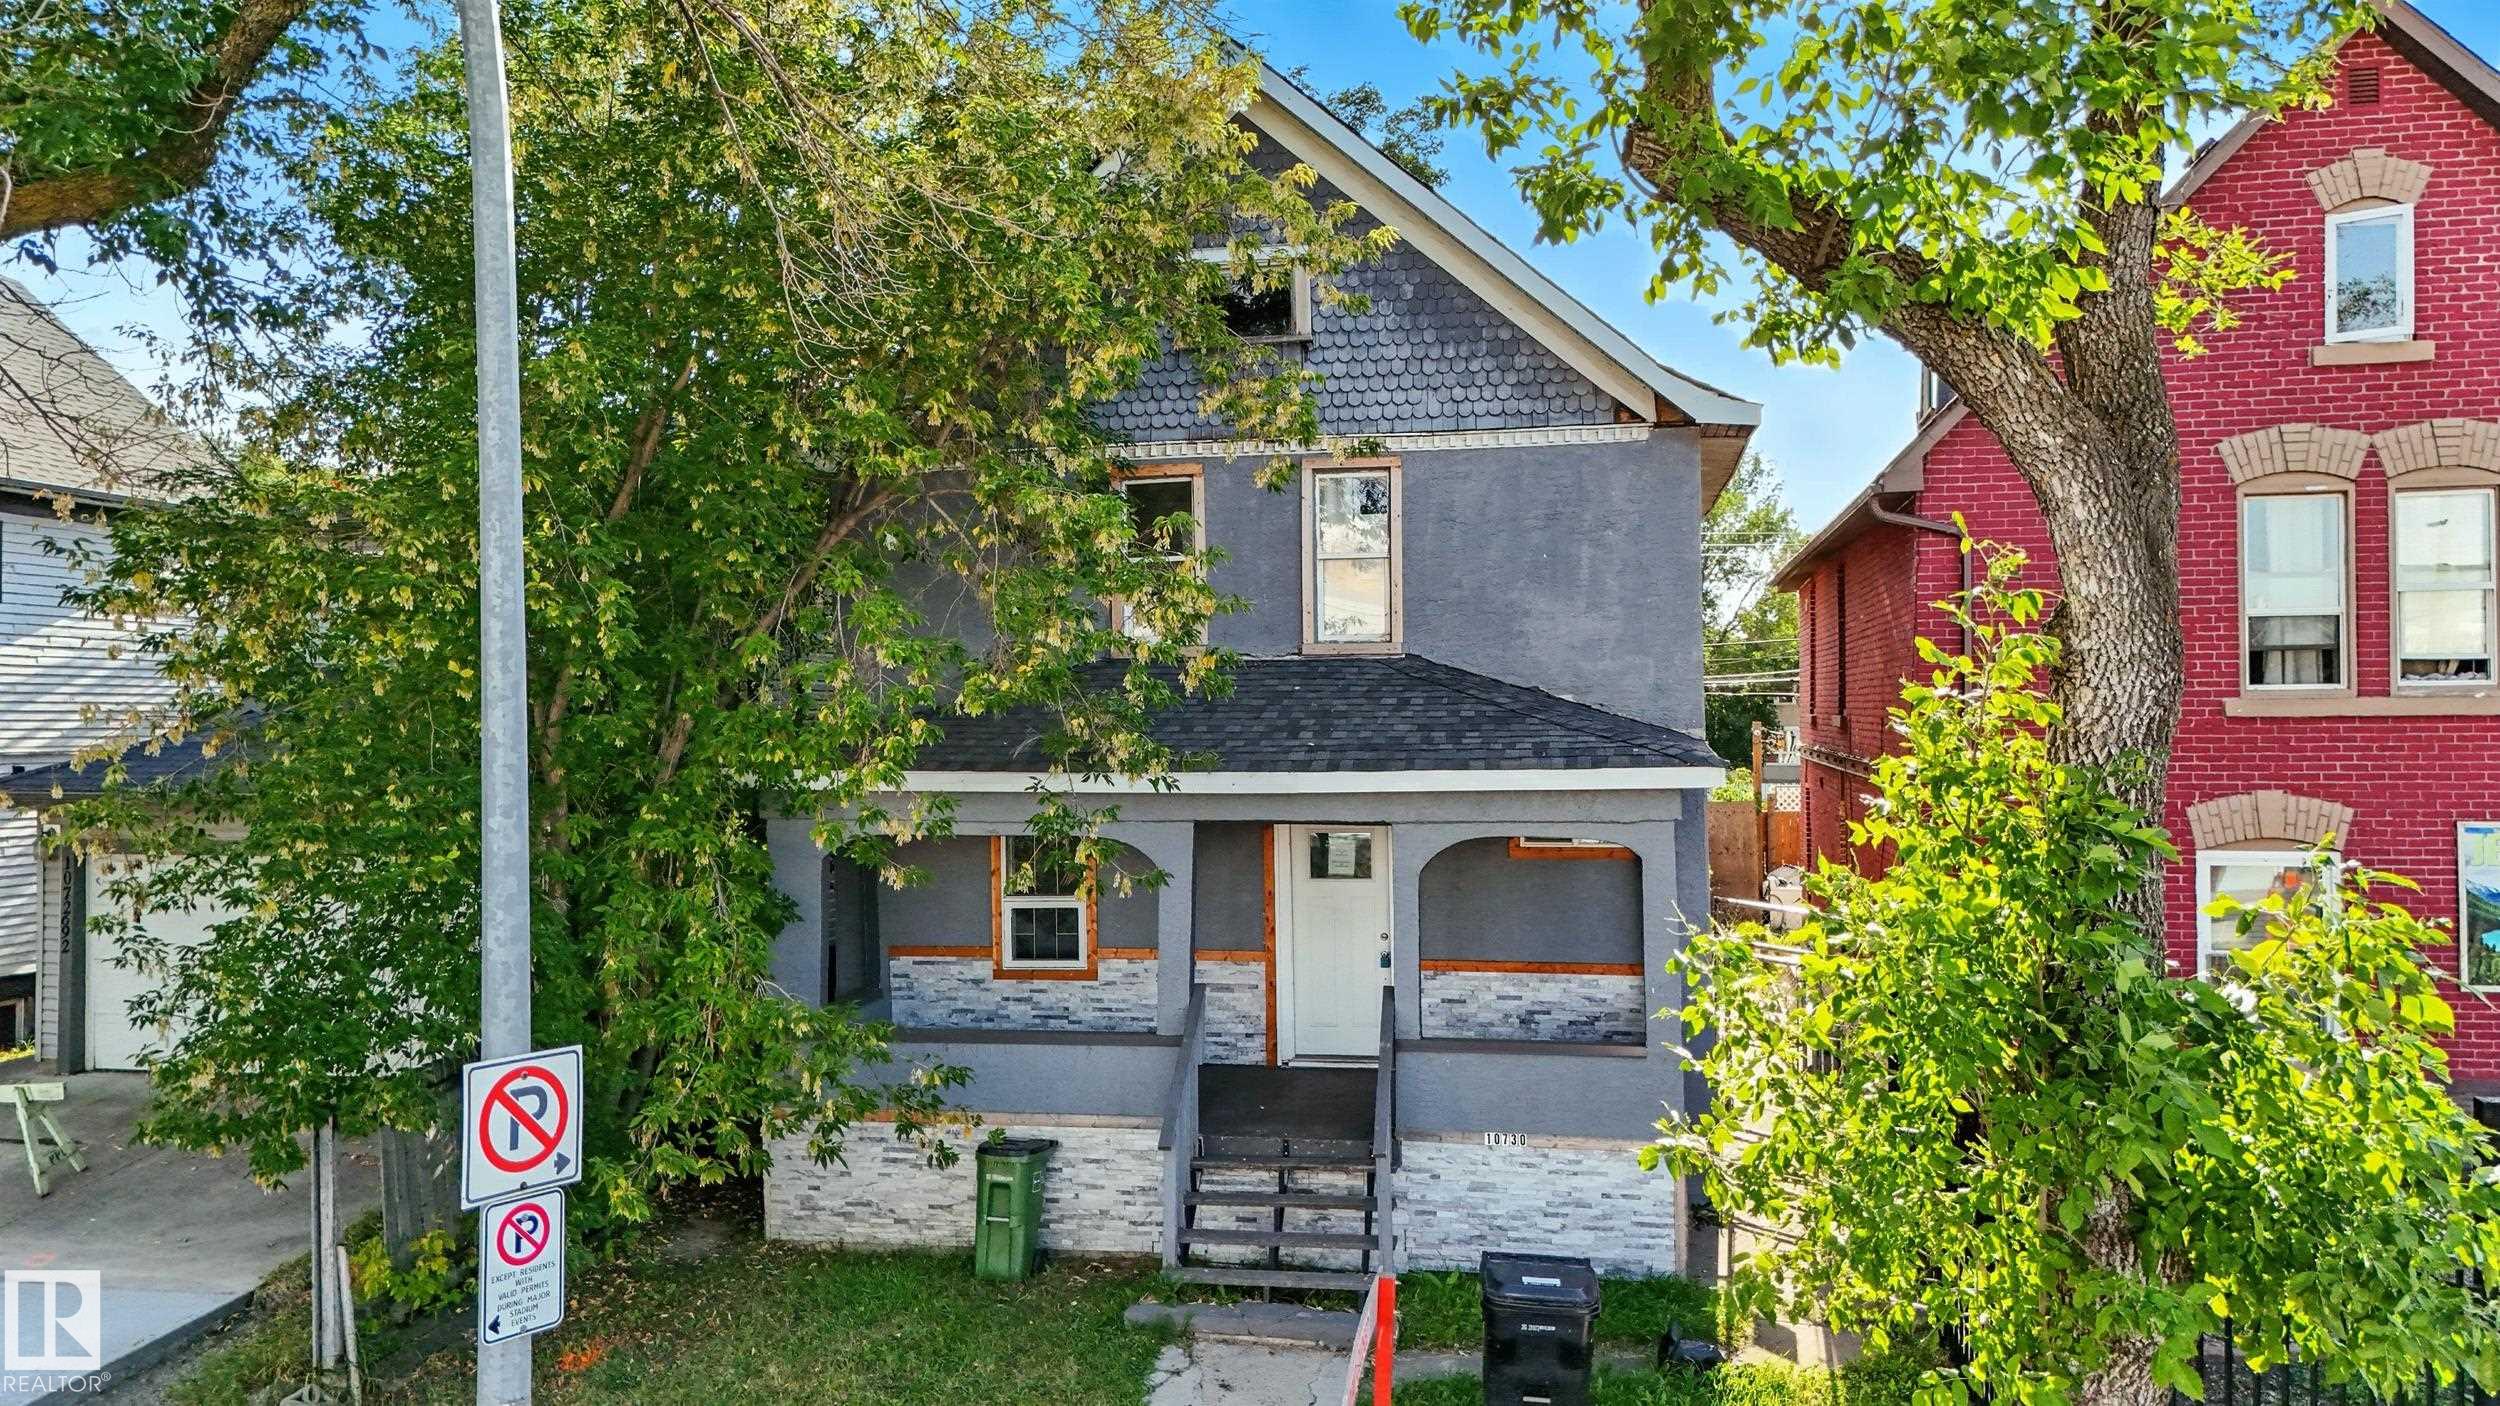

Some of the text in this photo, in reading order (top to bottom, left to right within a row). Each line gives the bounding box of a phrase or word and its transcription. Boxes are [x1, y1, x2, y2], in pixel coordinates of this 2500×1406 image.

[1487, 1133, 1526, 1146] 10730
[491, 1261, 555, 1284] EXCEPT RESIDENTS
[515, 1276, 532, 1287] WITH
[497, 1280, 549, 1301] VALID PERMITS
[497, 1290, 551, 1312] DURING MAJOR
[509, 1303, 539, 1318] STADIUM
[511, 1314, 537, 1327] EVENTS
